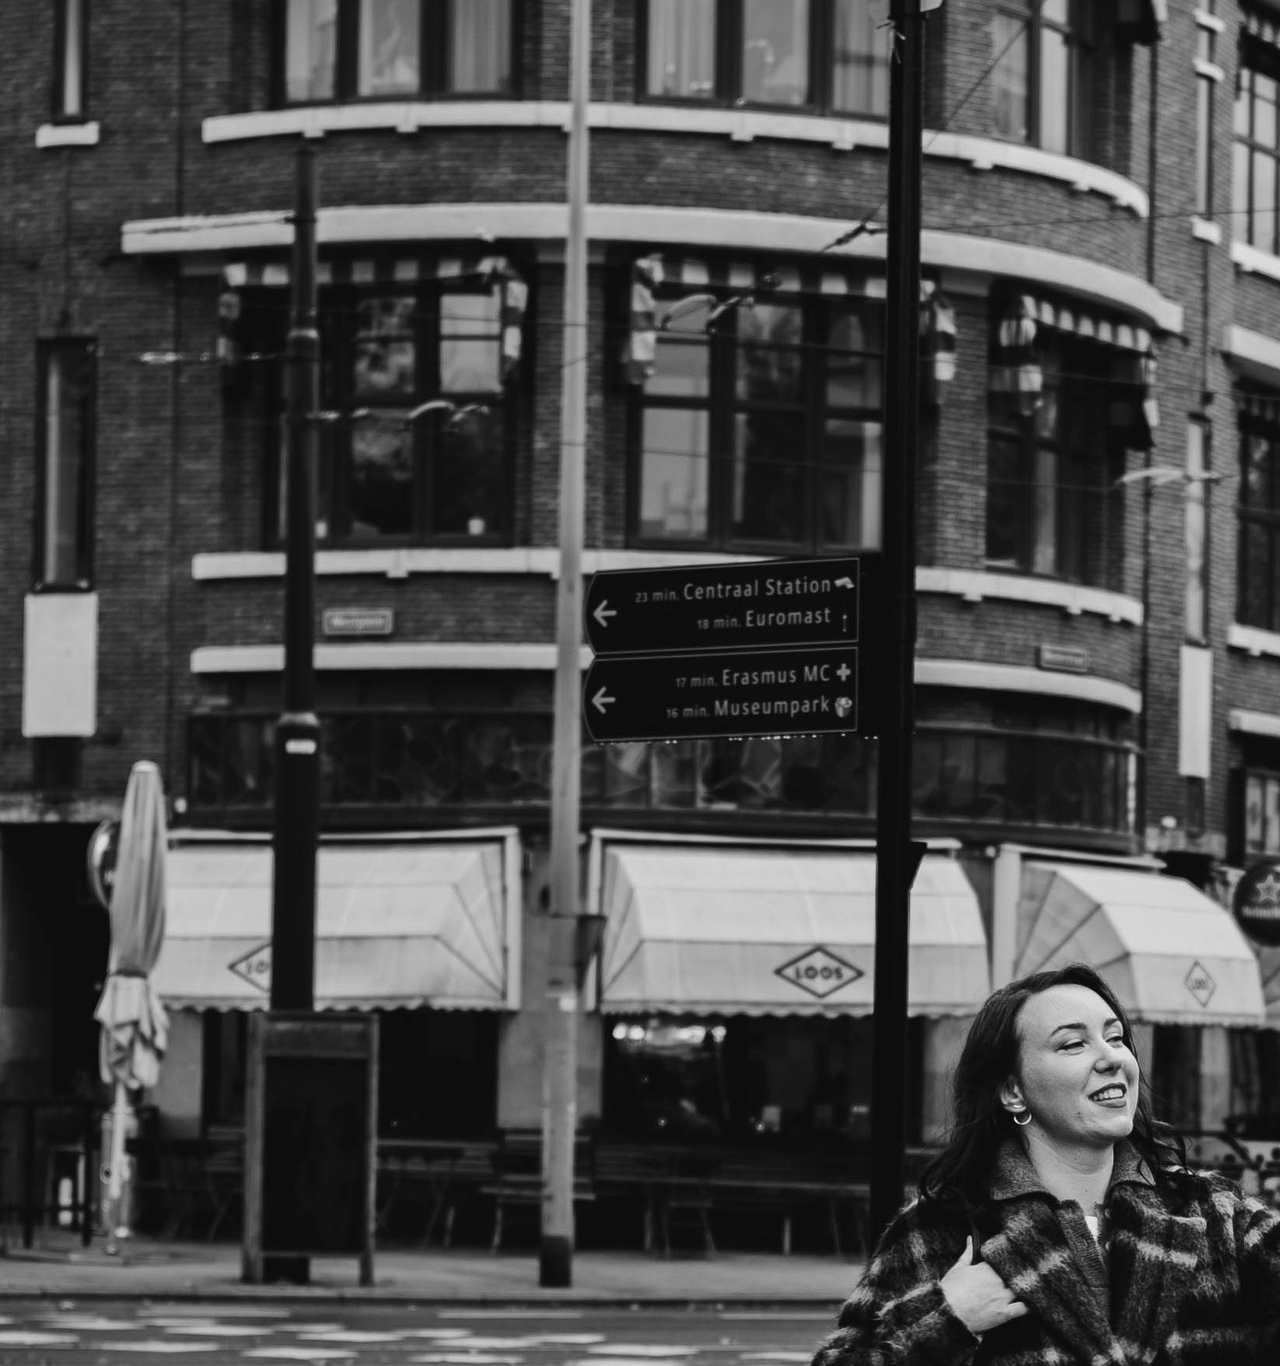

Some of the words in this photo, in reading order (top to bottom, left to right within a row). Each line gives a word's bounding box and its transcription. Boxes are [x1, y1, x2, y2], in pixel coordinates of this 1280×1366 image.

[635, 592, 648, 603] 23
[652, 590, 680, 602] min.
[683, 580, 759, 600] Centraal
[765, 577, 831, 596] Station
[697, 619, 709, 630] 18
[714, 615, 742, 628] min.
[746, 608, 831, 627] Euromast
[676, 678, 687, 688] 17
[691, 675, 718, 687] min.
[722, 669, 797, 686] Erasmus
[804, 665, 831, 682] MC
[666, 708, 679, 719] 16
[683, 704, 711, 718] min.
[715, 695, 830, 719] Museumpark
[795, 966, 843, 980] LOOS
